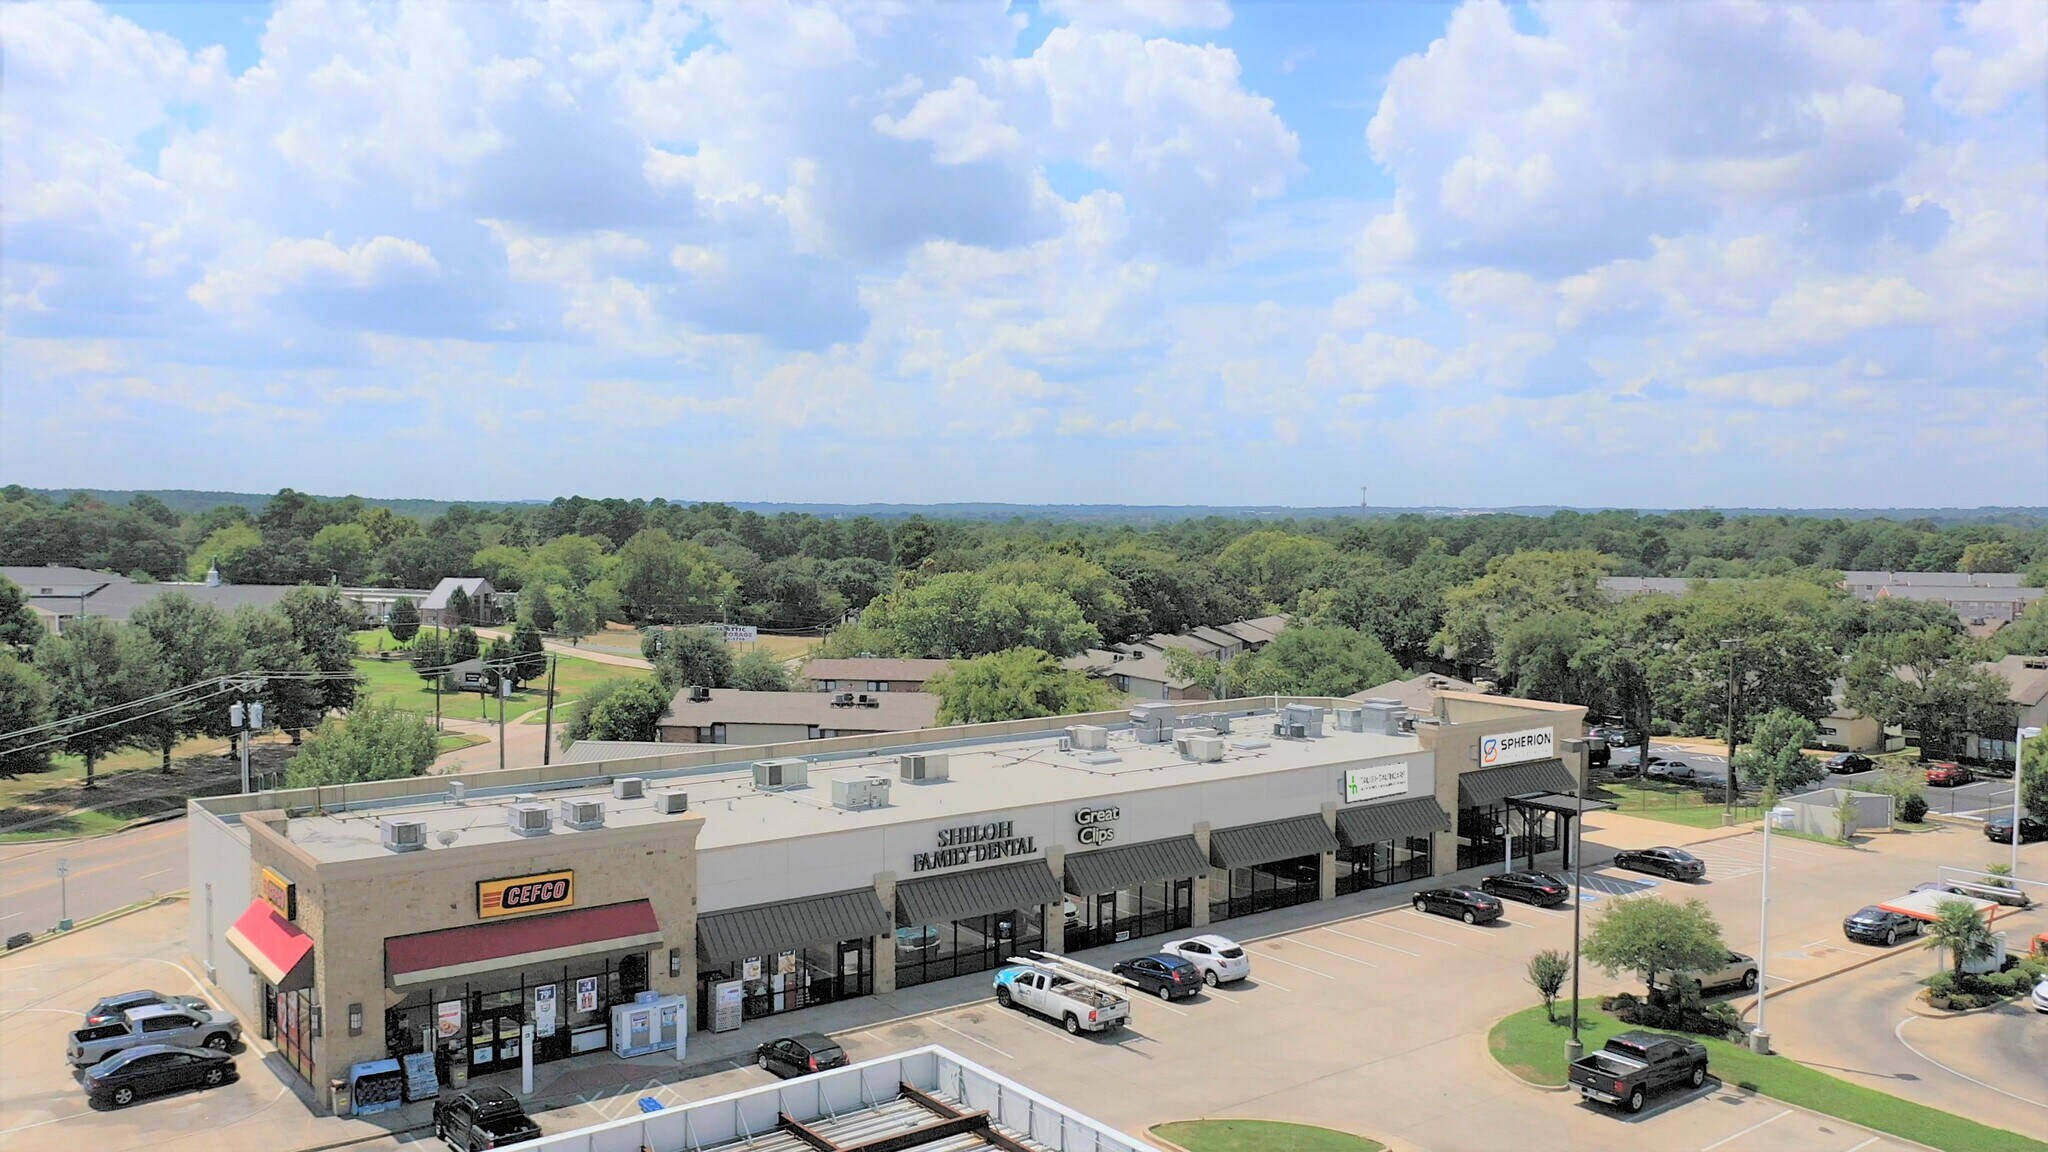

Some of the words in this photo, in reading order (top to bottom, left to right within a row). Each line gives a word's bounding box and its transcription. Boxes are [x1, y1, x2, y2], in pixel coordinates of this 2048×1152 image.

[1500, 732, 1551, 751] SPHERION
[1075, 807, 1120, 825] Great
[938, 820, 1014, 848] SHILOH
[1078, 826, 1115, 846] Clips
[913, 845, 971, 872] FAMILY
[975, 836, 1037, 862] DENTAL
[507, 881, 566, 905] CEFCO
